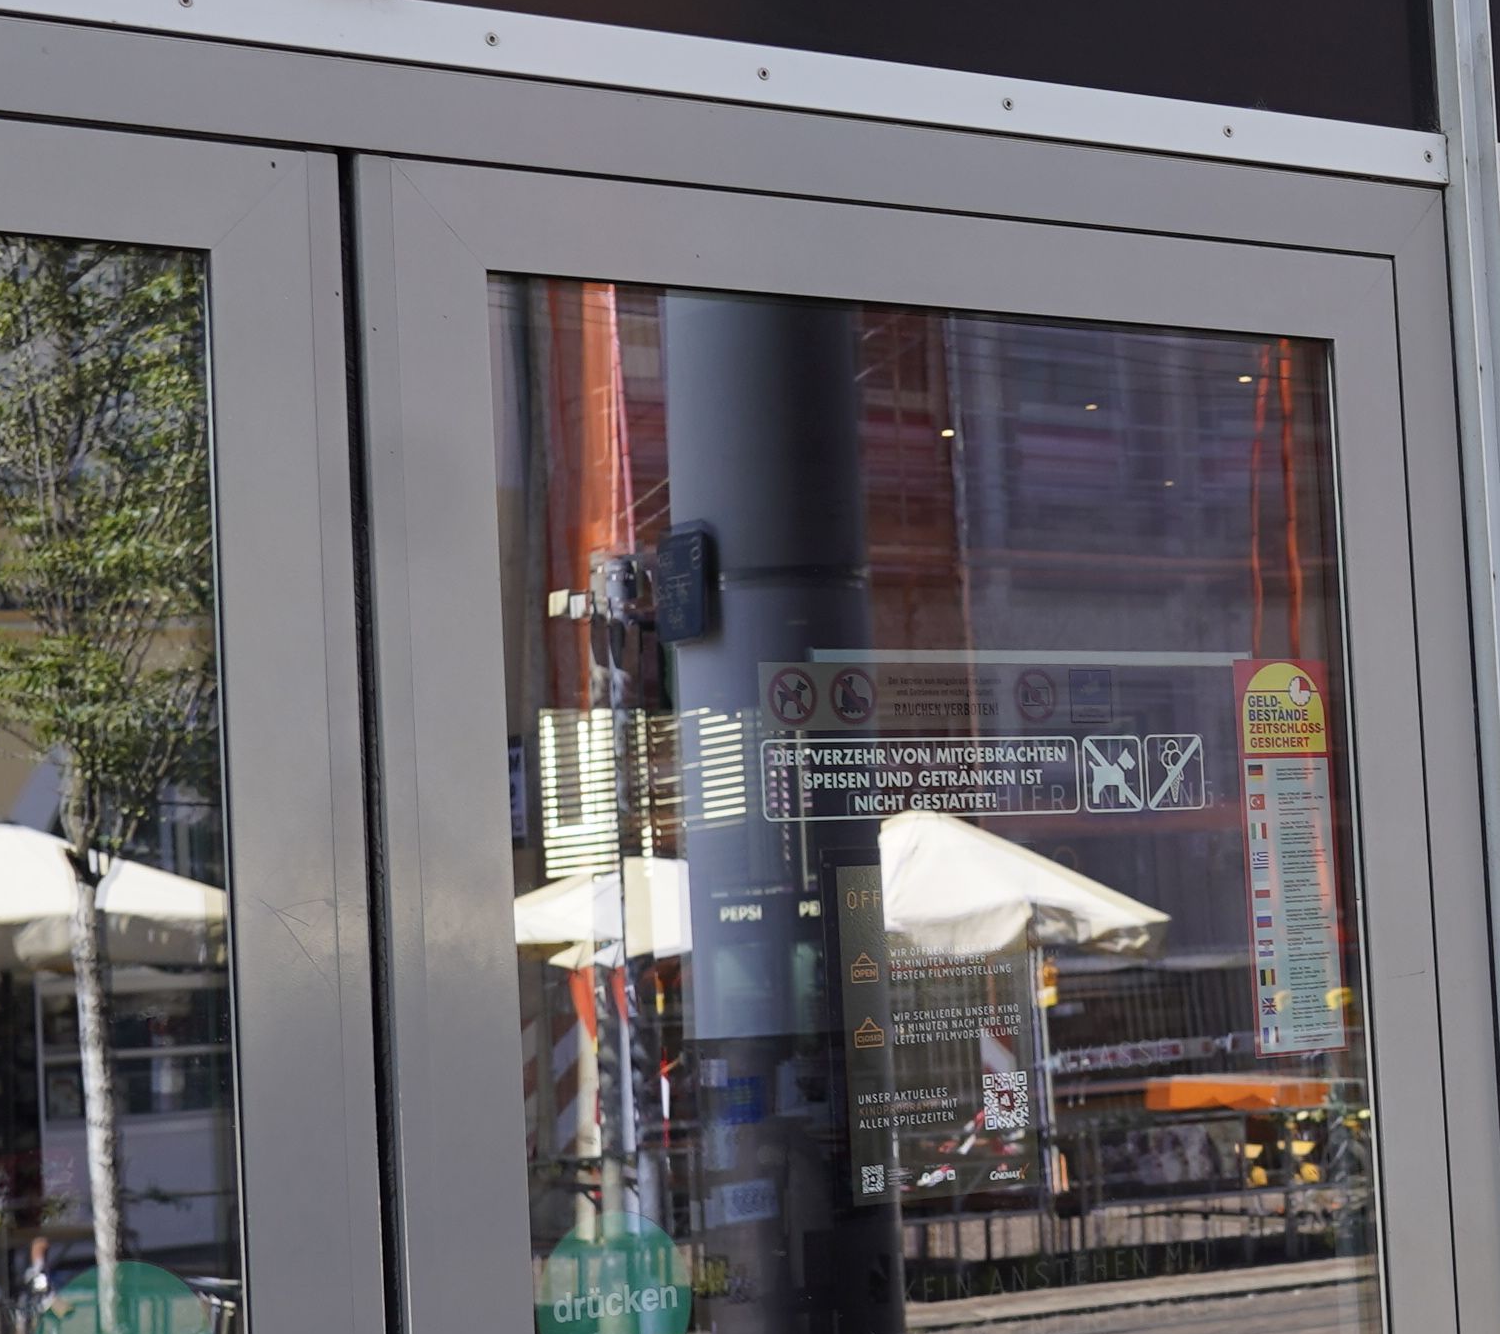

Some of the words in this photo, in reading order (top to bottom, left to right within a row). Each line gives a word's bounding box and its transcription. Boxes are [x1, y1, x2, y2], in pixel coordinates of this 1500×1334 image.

[1247, 695, 1281, 708] GELD-
[893, 702, 941, 716] RAUCHEN
[1248, 706, 1309, 722] BESTÄNDE
[1249, 722, 1325, 734] ZEITSCHLOSS-
[1250, 736, 1311, 749] GESICHERT
[773, 749, 805, 767] DER
[809, 748, 887, 767] VERZEHR
[890, 747, 931, 765] VON
[936, 745, 1067, 764] MITGEBRACHTEN
[802, 771, 871, 790] SPEISEN
[875, 770, 913, 788] UND
[918, 765, 1016, 787] GETRÄNKEN
[1021, 769, 1043, 785] IST
[854, 793, 907, 812] NICHT
[911, 792, 998, 811] GESTATTET!
[719, 903, 762, 923] PEPSI
[889, 947, 907, 958] WIR
[891, 959, 901, 969] 15
[905, 956, 946, 968] MINUTEN
[947, 955, 967, 966] VOR
[969, 954, 987, 965] DER
[853, 968, 877, 979] OPEN
[891, 969, 926, 981] ERSTEN
[892, 1011, 911, 1022] WIR
[965, 1005, 996, 1016] UNSER
[998, 1002, 1020, 1014] KINO
[908, 1020, 949, 1033] MINUTEN
[951, 1017, 975, 1029] NACH
[978, 1015, 1001, 1027] ENDE
[1004, 1014, 1022, 1025] DER
[856, 1034, 883, 1044] CLOSED
[894, 1033, 933, 1046] LETZTEN
[857, 1092, 891, 1105] UNSER
[893, 1087, 949, 1102] AKTUELLES
[941, 1097, 959, 1109] MIT
[859, 1117, 890, 1130] ALLEN
[553, 1282, 678, 1324] drücken
